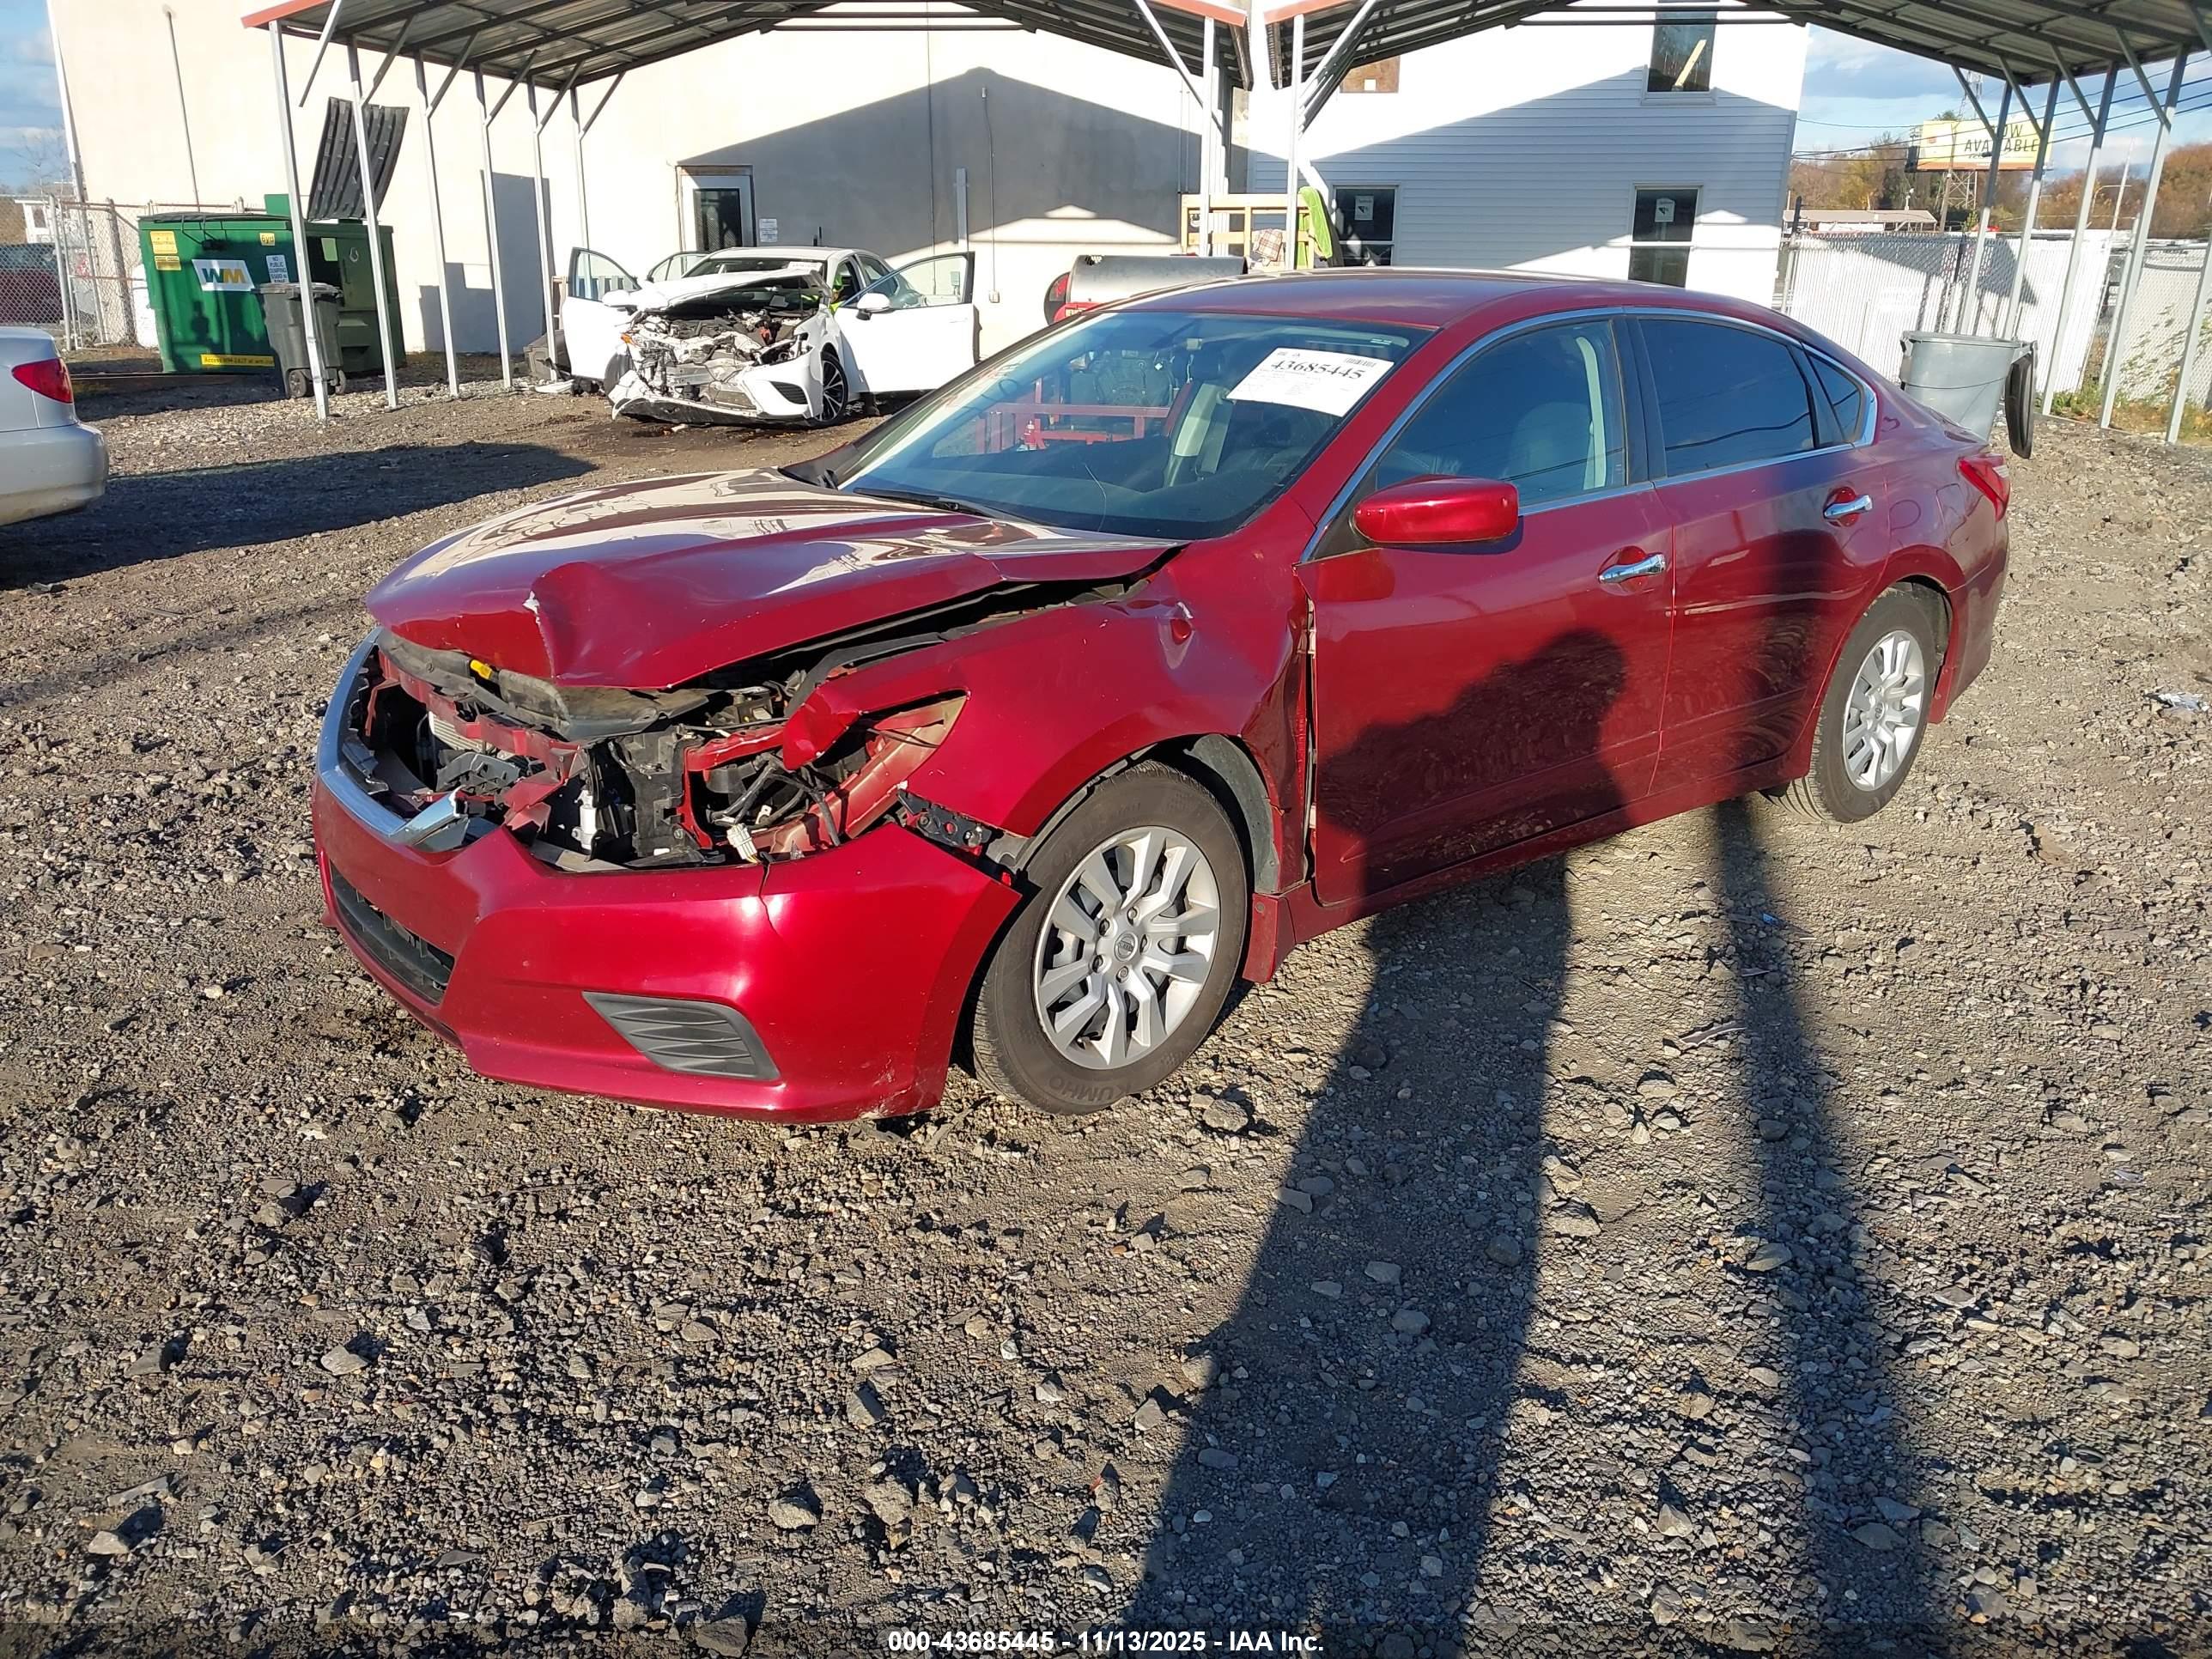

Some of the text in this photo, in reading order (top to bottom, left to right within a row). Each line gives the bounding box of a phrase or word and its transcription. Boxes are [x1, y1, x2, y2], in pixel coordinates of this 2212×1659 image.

[1991, 124, 2024, 138] OW
[1964, 138, 2039, 152] AVAABLE
[201, 268, 247, 283] WM
[1271, 359, 1366, 380] 43685445
